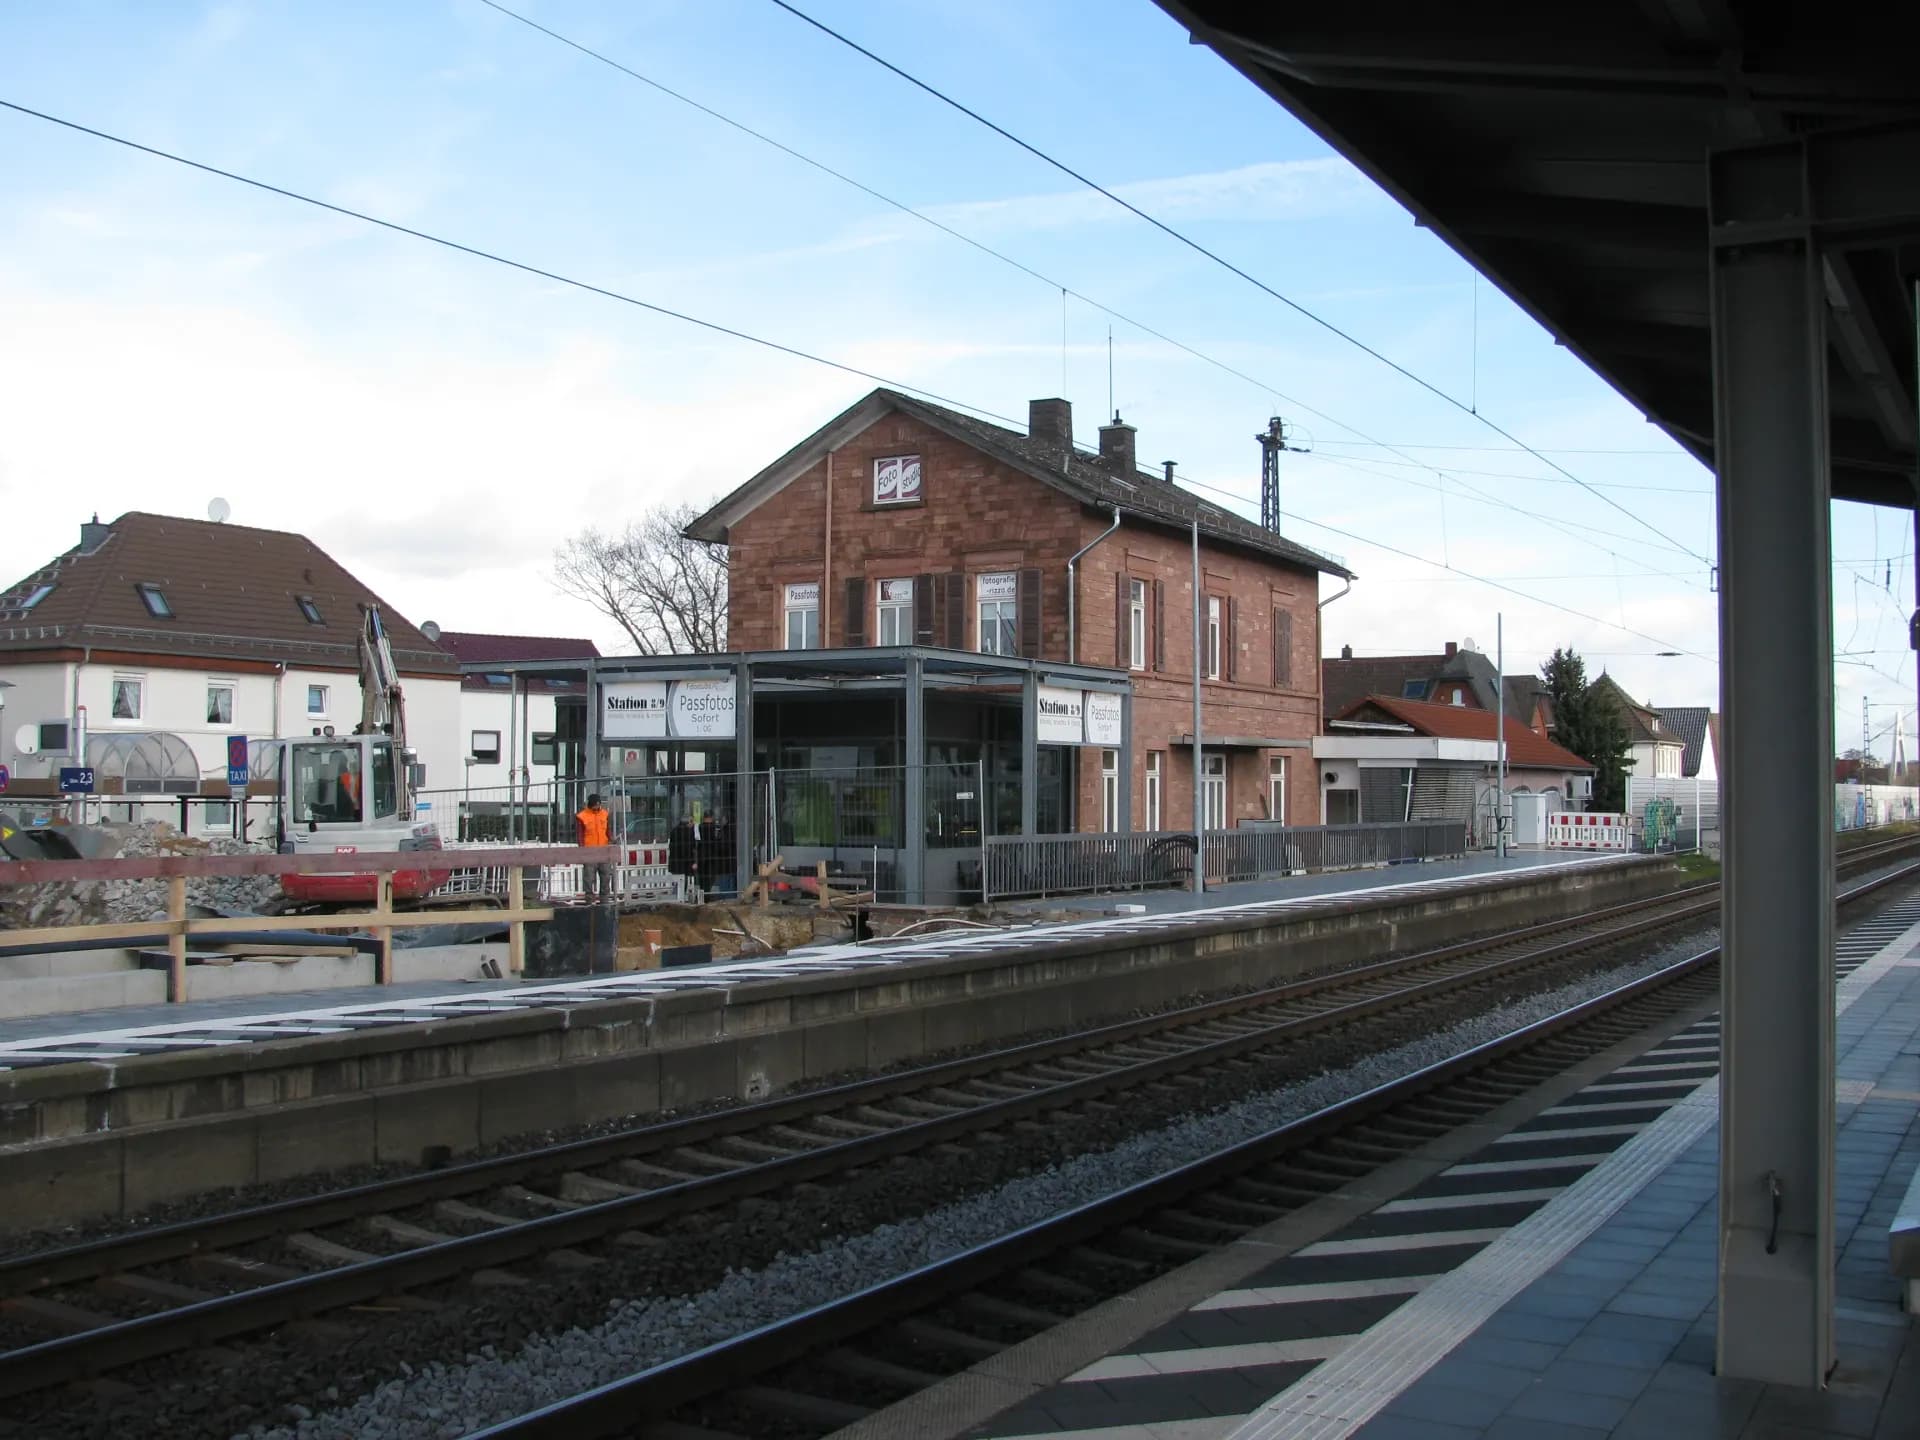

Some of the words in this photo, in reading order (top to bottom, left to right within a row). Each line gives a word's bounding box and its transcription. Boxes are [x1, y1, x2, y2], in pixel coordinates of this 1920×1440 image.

[879, 469, 897, 491] Foto
[607, 696, 647, 710] Station
[651, 697, 665, 708] 8/9
[680, 694, 735, 711] Passfotos
[1039, 697, 1069, 715] Station
[691, 713, 720, 723] Sofort
[1091, 705, 1120, 720] Passfotos
[80, 772, 93, 785] 2,3
[230, 770, 247, 781] TAXI
